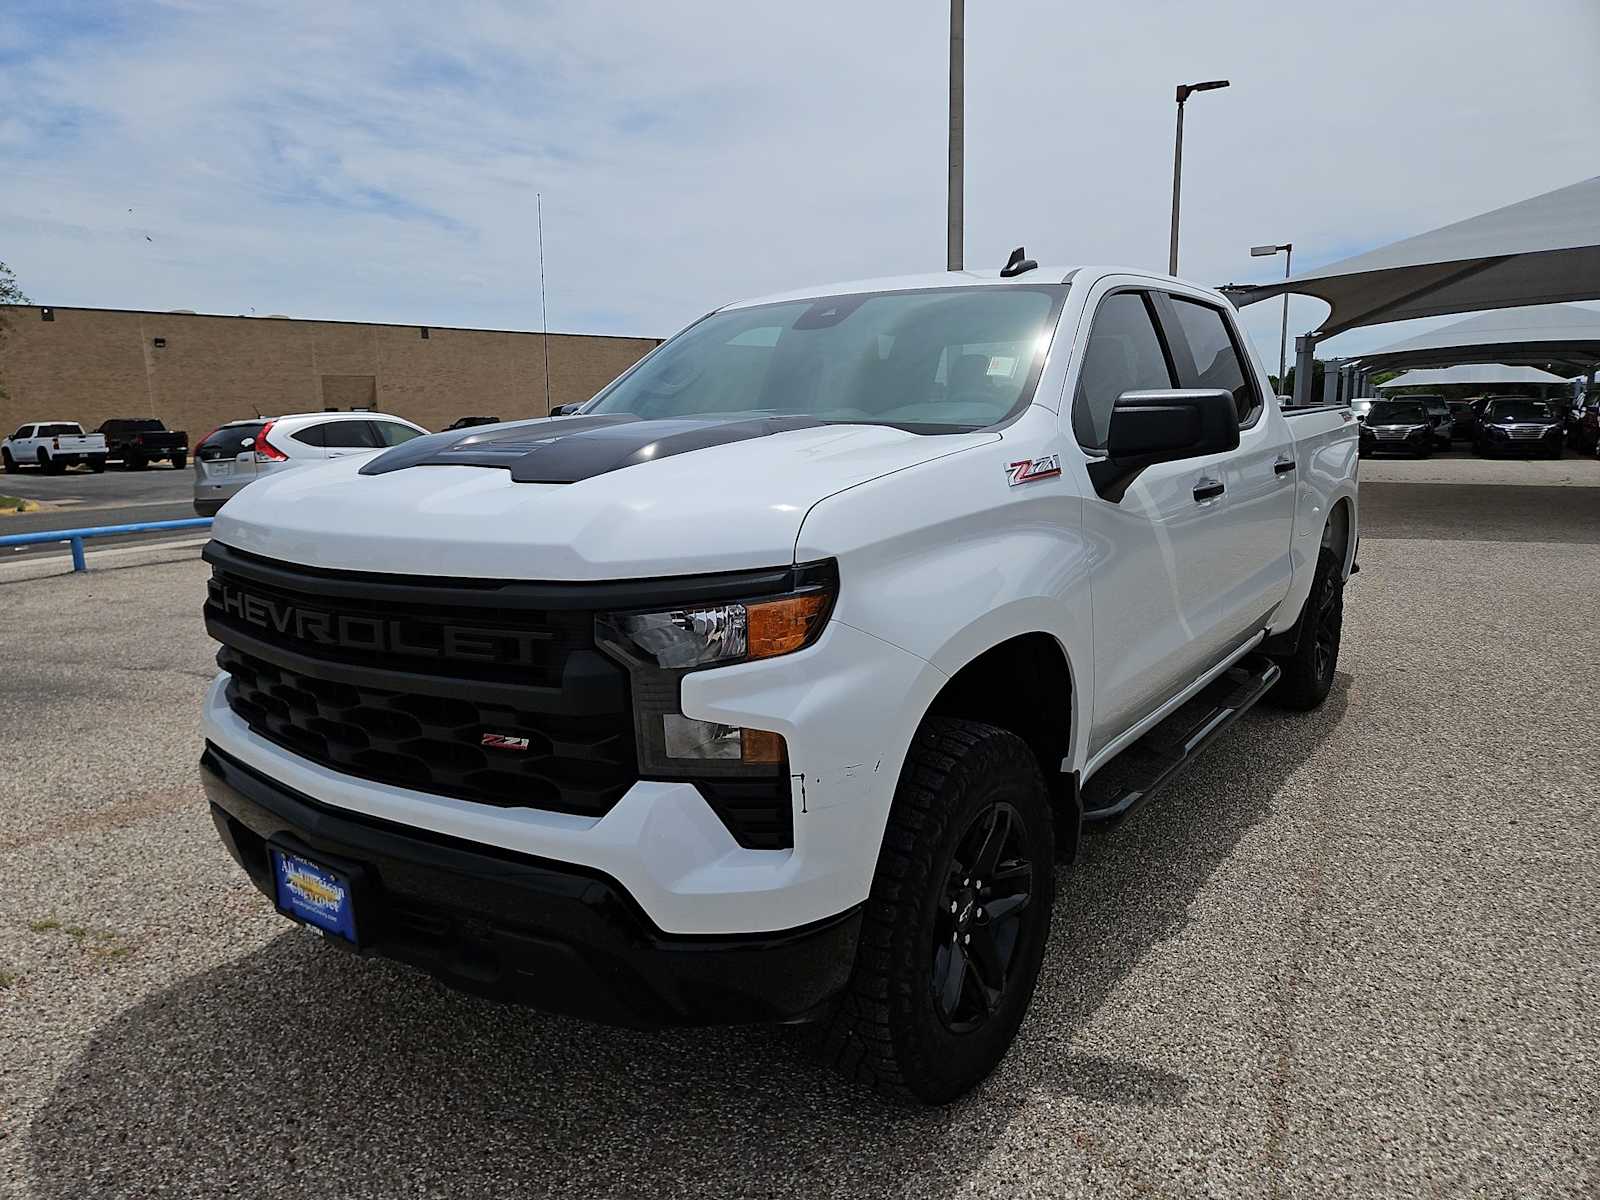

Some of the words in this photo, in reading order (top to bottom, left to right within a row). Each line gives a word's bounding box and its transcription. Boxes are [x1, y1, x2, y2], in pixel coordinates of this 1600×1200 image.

[1005, 454, 1061, 487] Z71
[207, 581, 554, 664] CHEVROLET
[481, 733, 530, 750] Z71
